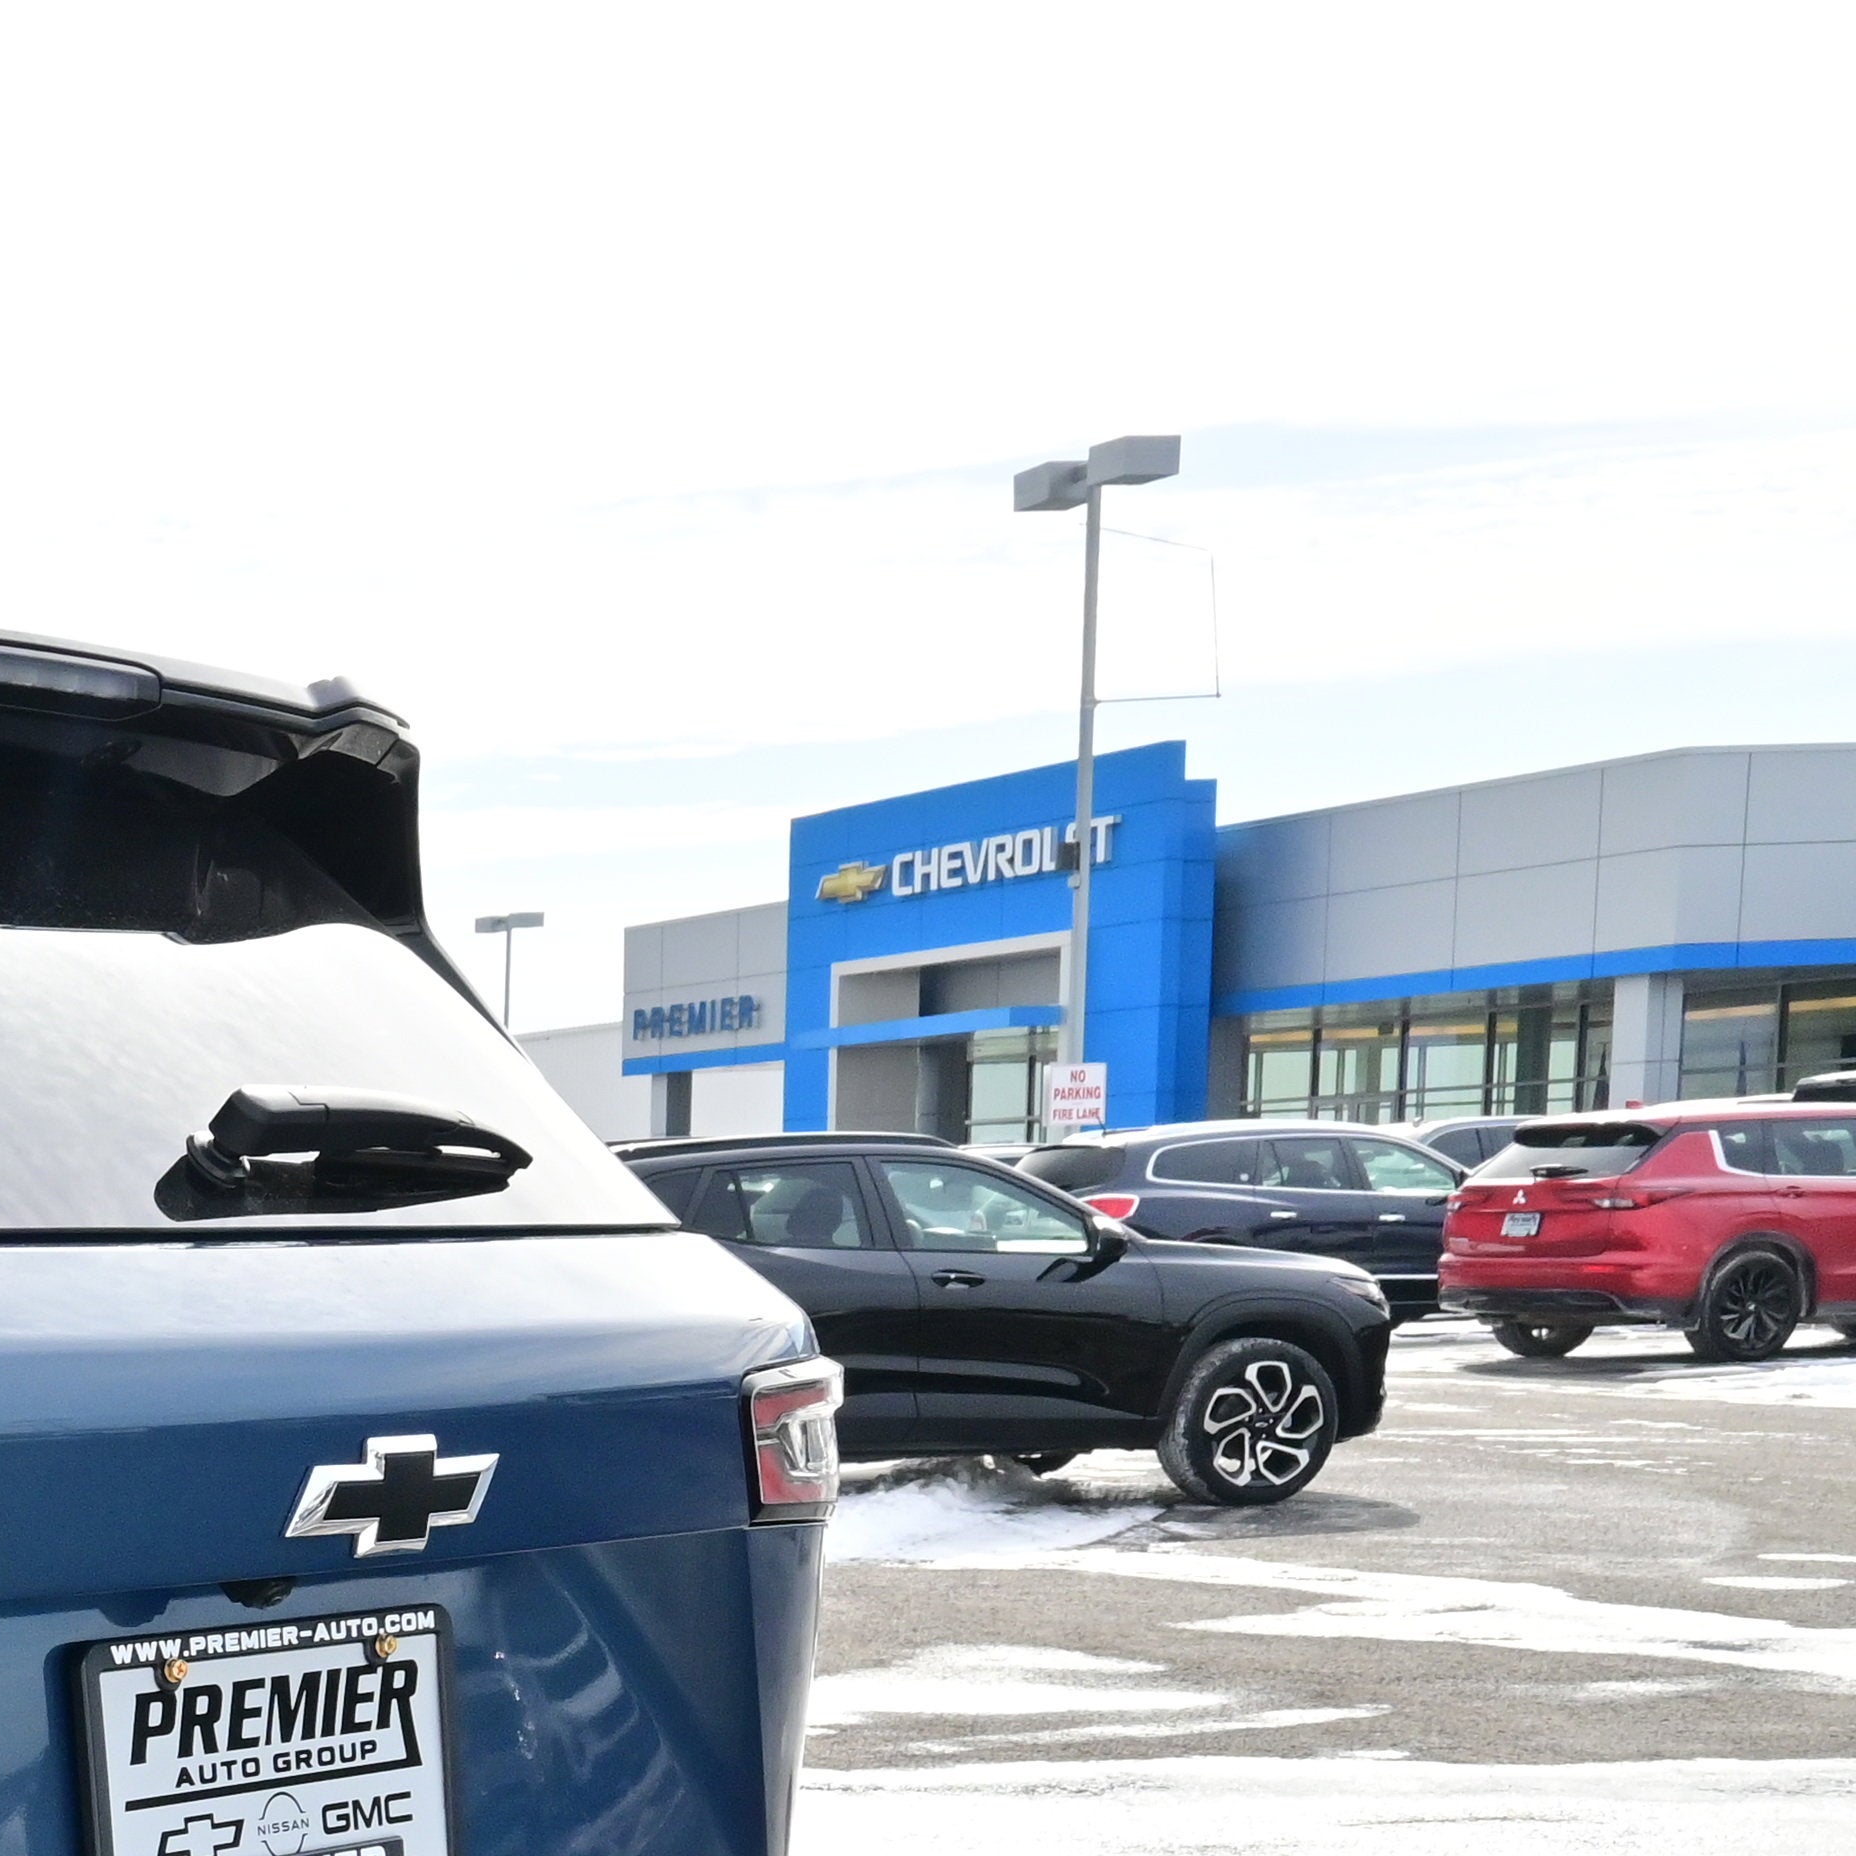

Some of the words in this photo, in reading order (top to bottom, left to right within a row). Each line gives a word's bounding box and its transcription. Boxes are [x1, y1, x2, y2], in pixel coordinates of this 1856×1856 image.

[633, 995, 759, 1041] PREMIER
[1053, 1086, 1101, 1101] PARKING
[1070, 1069, 1086, 1083] NO
[1053, 1108, 1073, 1120] FIRE
[111, 1610, 435, 1665] WWW.PREMIER-AUTO.COM
[130, 1659, 422, 1765] PREMIER
[175, 1757, 261, 1788] AUTO
[273, 1739, 377, 1773] GROUP
[256, 1817, 310, 1836] NISSAN
[322, 1791, 413, 1834] GMC
